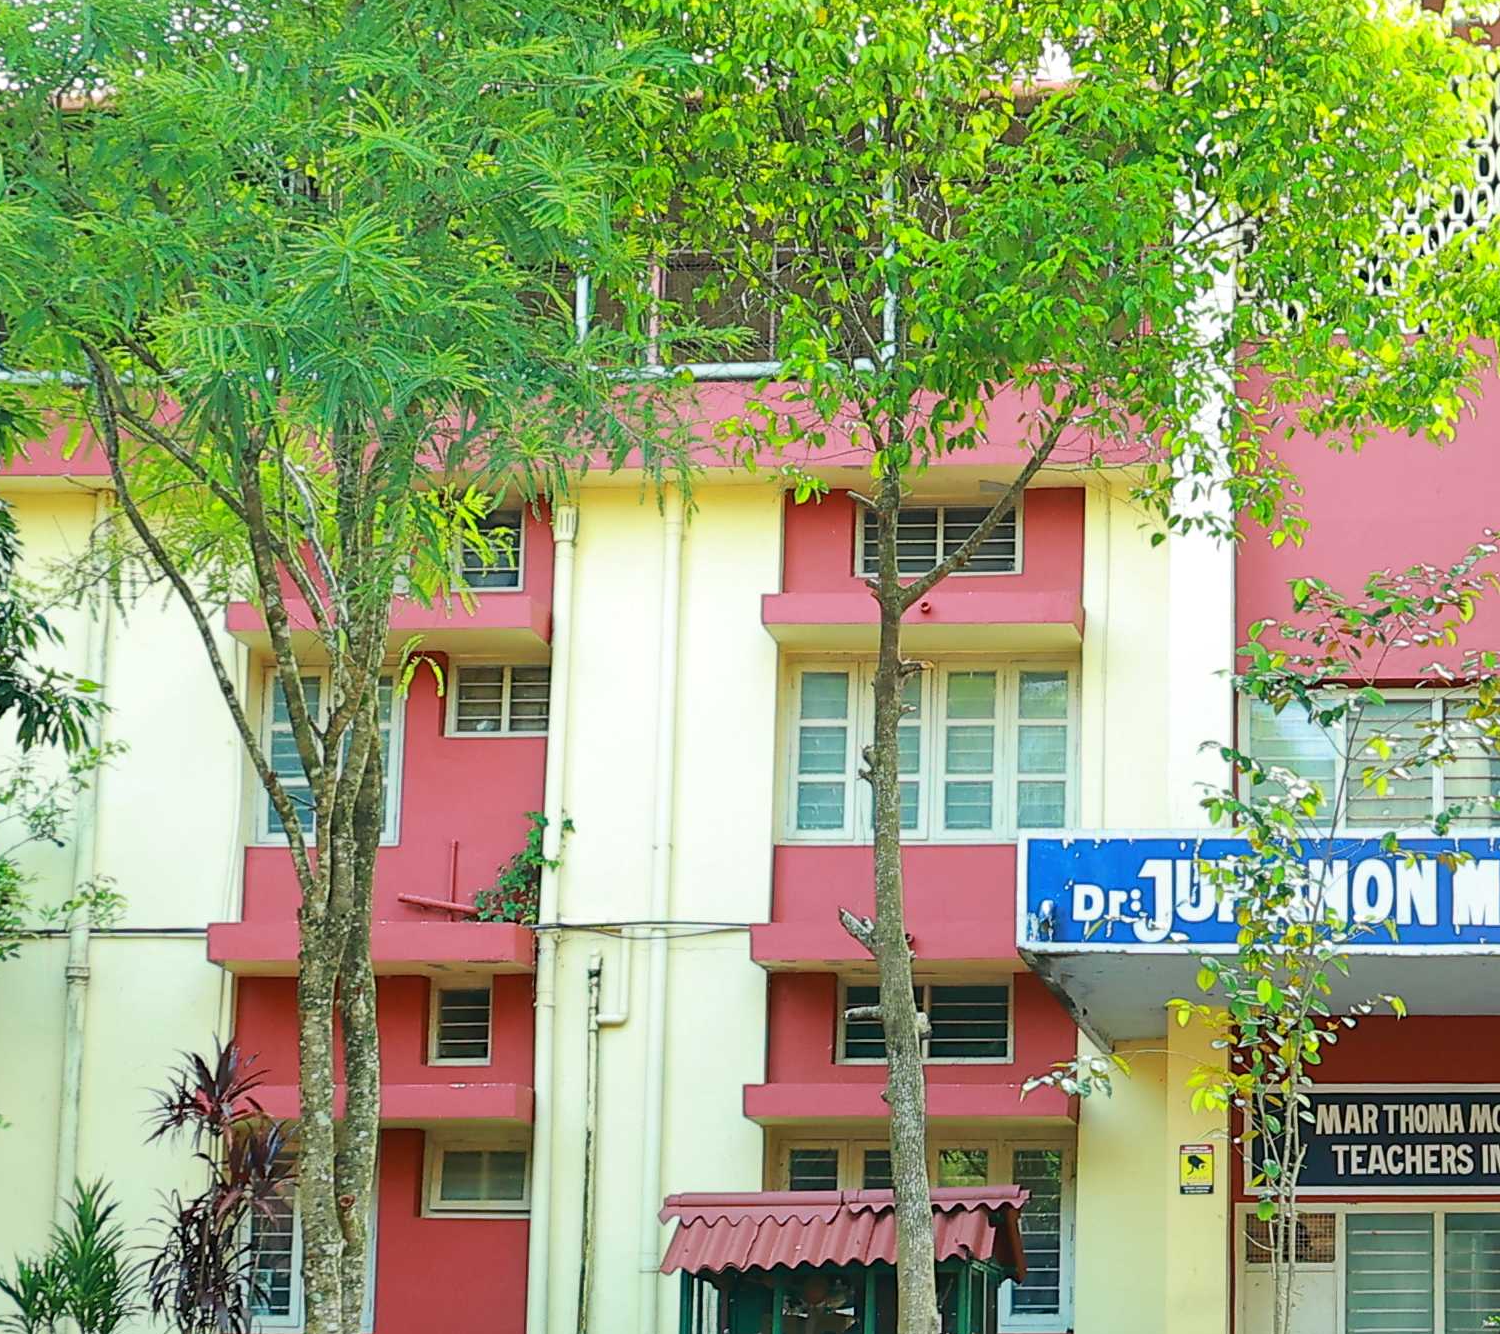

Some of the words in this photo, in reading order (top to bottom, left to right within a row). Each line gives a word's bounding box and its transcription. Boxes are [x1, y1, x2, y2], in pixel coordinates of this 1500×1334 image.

[1315, 1104, 1378, 1135] MAR
[1382, 1103, 1461, 1134] THOMA
[1331, 1143, 1475, 1175] TEACHERS
